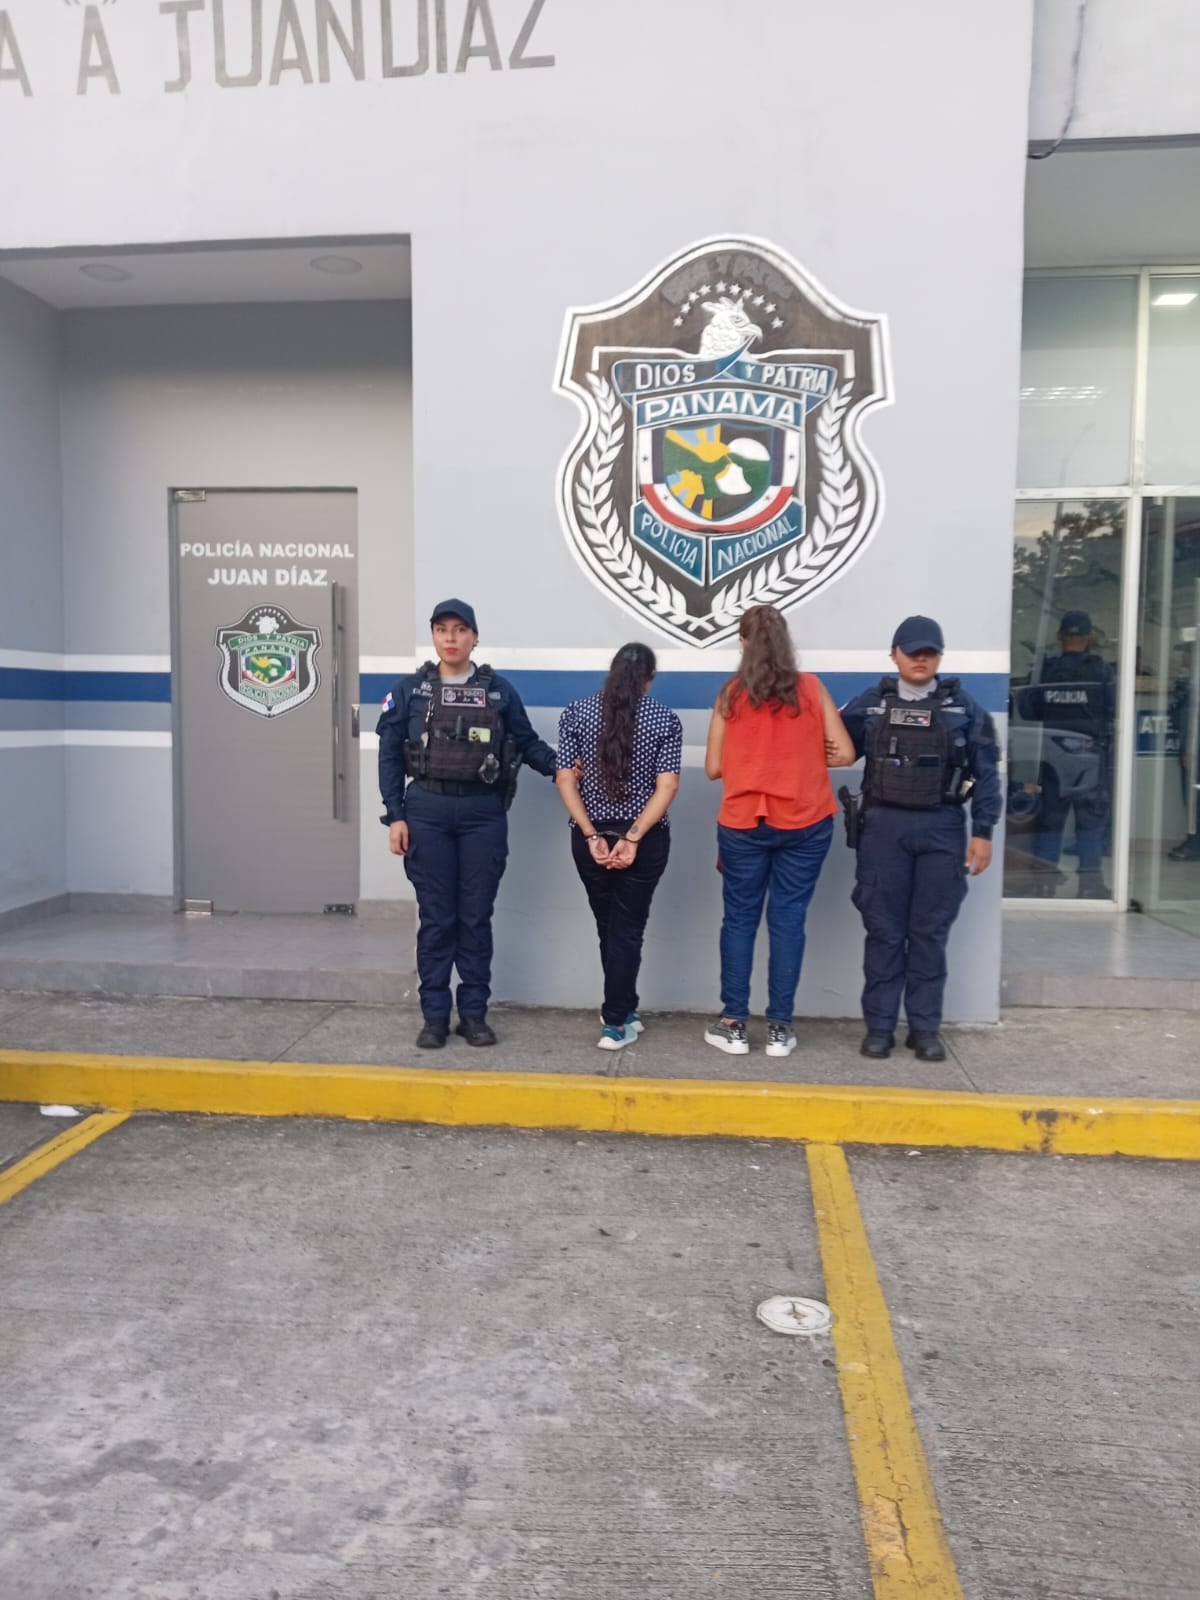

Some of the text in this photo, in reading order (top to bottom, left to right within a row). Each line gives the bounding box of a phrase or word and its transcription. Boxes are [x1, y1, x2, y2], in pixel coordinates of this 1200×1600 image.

[634, 364, 829, 394] DIOS Y PATRIA
[643, 393, 796, 424] PANAMA
[180, 540, 355, 558] POLICÍA NACIONAL
[641, 512, 798, 571] POLICIA NACIONAL
[207, 565, 328, 586] JUAN DÍAZ
[238, 634, 258, 644] DIOS
[276, 634, 306, 647] PATRIA
[1140, 716, 1179, 734] ATE
